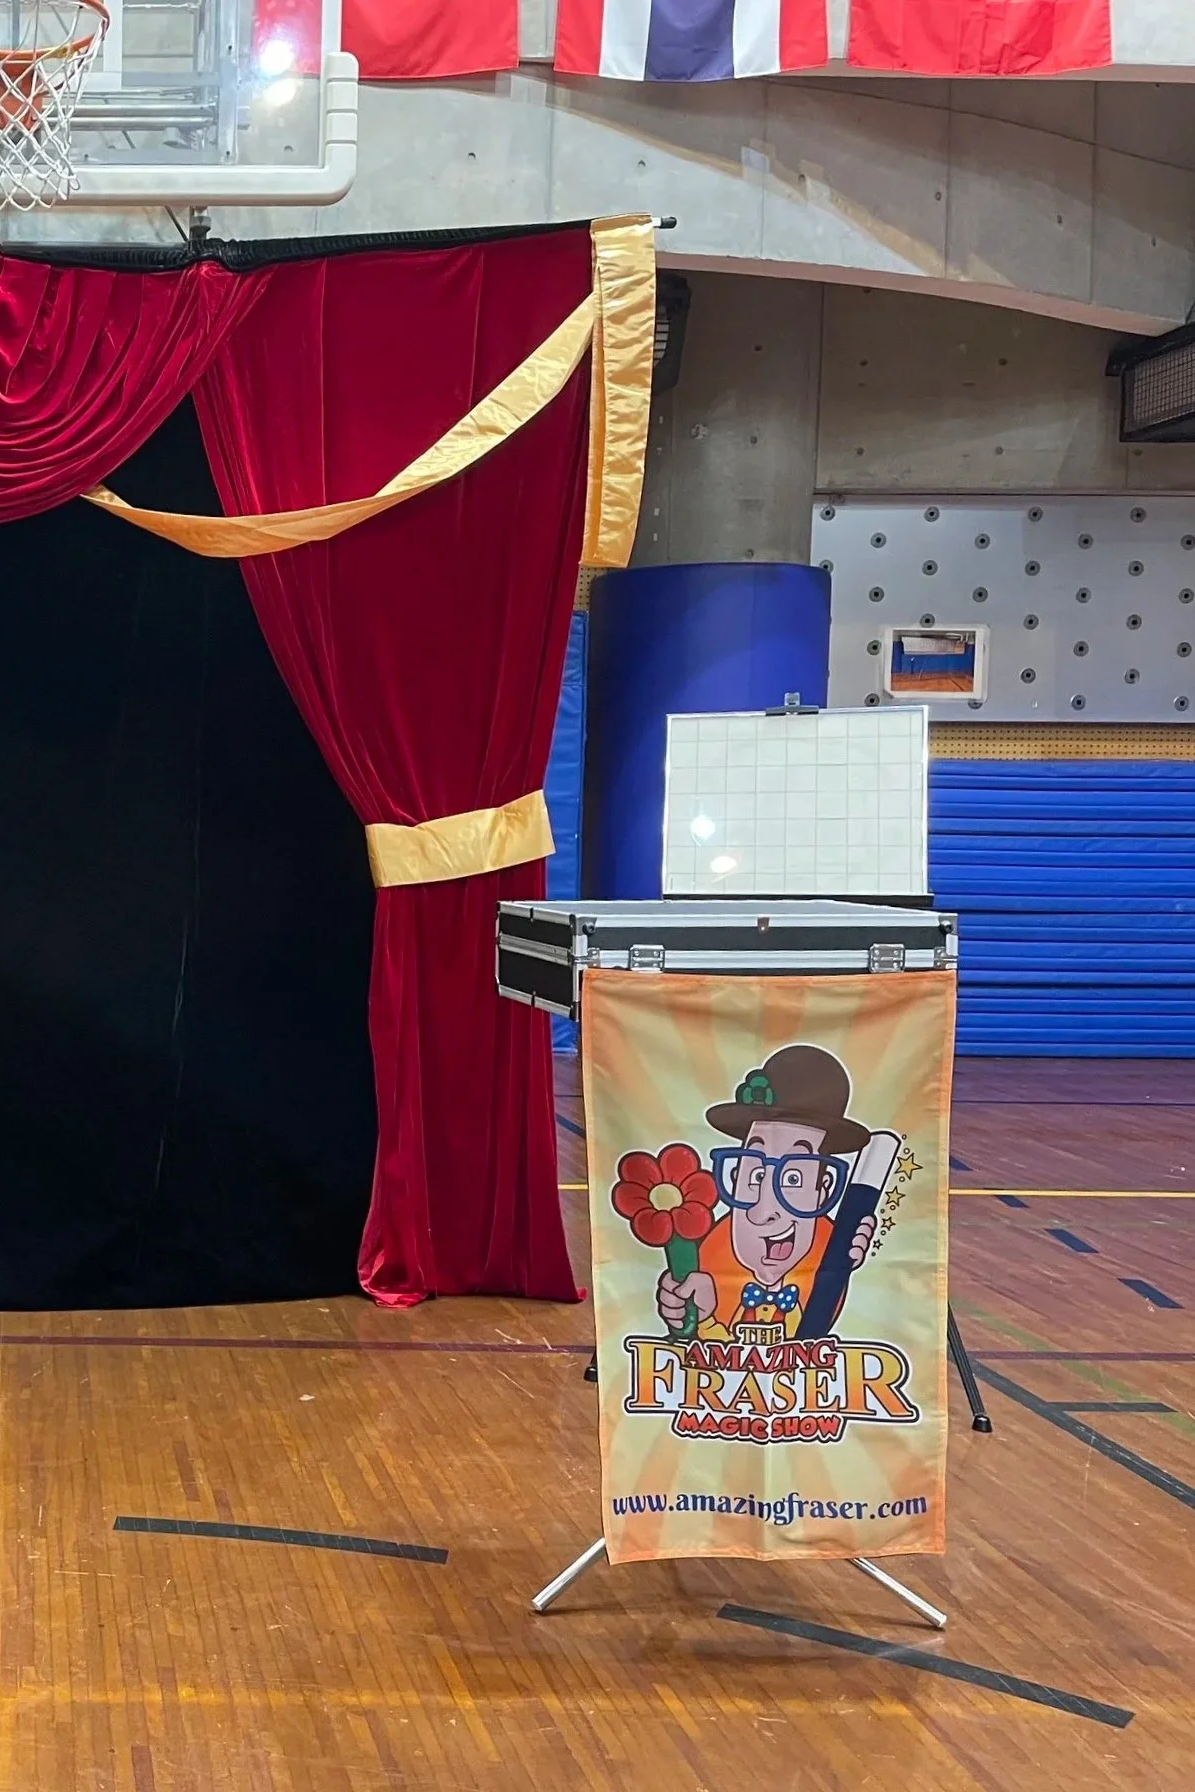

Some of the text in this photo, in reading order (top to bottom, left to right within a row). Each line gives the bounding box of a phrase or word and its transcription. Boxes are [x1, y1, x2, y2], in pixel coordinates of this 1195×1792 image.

[739, 1326, 782, 1345] THE
[685, 1341, 836, 1374] AMAZING
[628, 1342, 916, 1417] FRASER
[677, 1413, 841, 1438] MAGIC SHOW
[613, 1493, 927, 1526] www.amazingfraser.com
